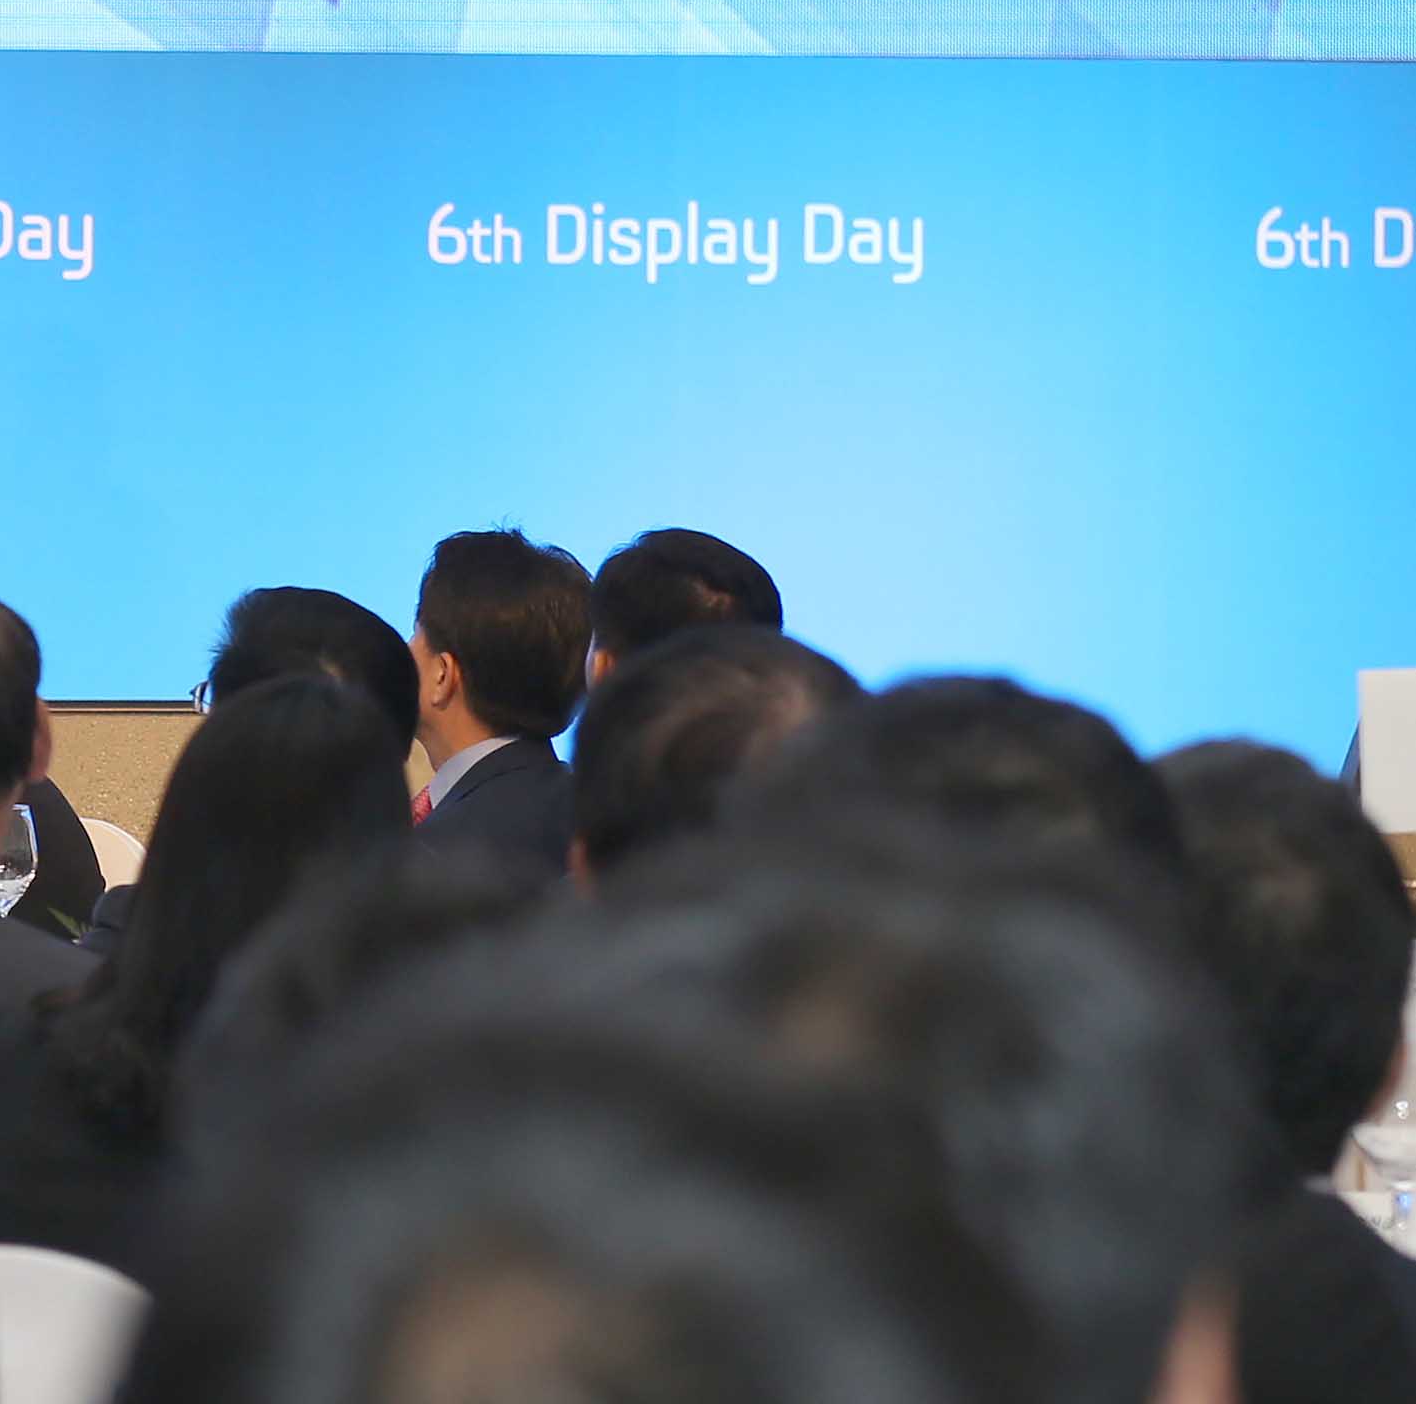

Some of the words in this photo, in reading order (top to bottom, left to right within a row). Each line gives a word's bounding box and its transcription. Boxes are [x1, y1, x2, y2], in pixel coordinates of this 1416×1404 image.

[427, 203, 523, 265] 6th
[546, 201, 779, 285] Display
[803, 204, 925, 285] Day
[1256, 206, 1351, 269] 6th
